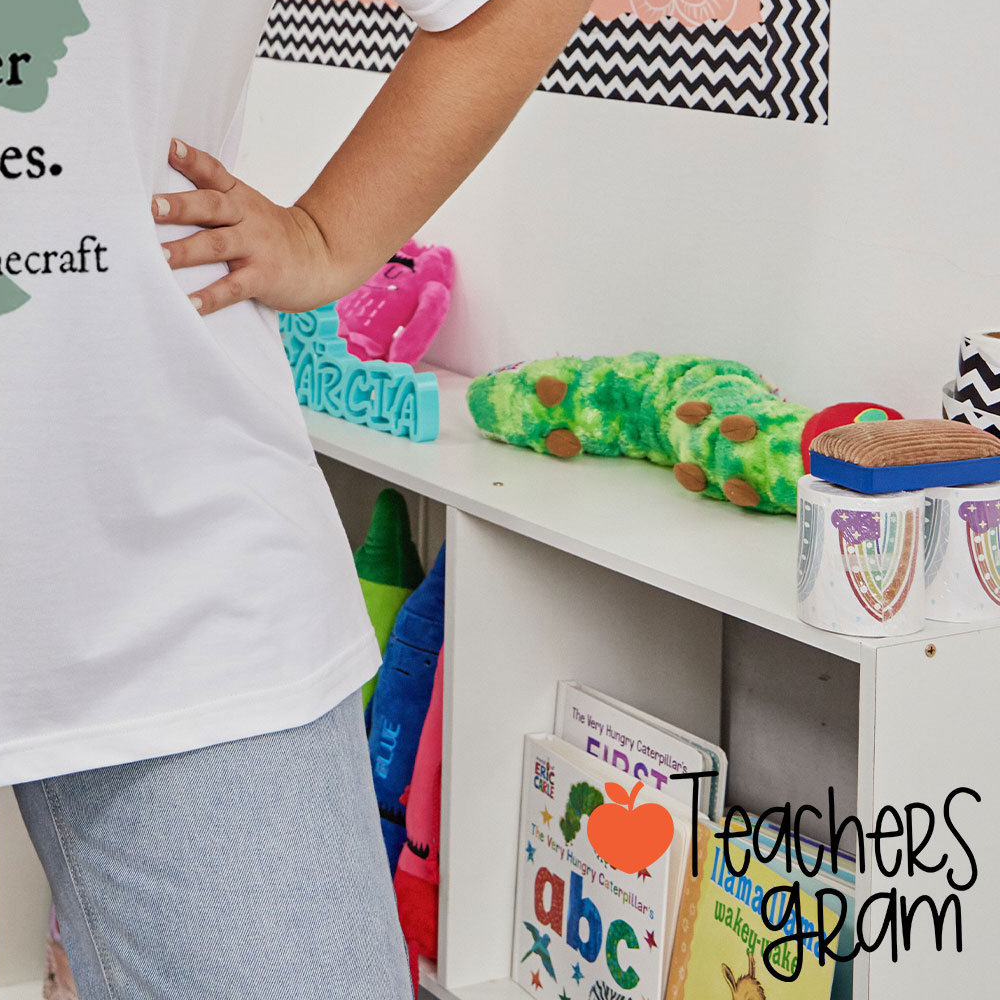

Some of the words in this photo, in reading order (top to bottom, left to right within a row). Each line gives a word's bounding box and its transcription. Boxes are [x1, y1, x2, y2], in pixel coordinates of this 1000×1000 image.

[297, 352, 419, 436] ARCIA
[374, 718, 402, 779] BLUE
[535, 761, 556, 786] ERIC
[572, 706, 586, 724] The
[587, 714, 605, 736] Very
[606, 724, 635, 751] Hungry
[636, 739, 689, 775] Caterpillar's
[533, 775, 555, 800] CARLE
[531, 822, 545, 842] The
[547, 834, 565, 860] Very
[566, 849, 596, 884] Hungry
[598, 872, 655, 920] Caterpillar's
[533, 866, 640, 991] abc
